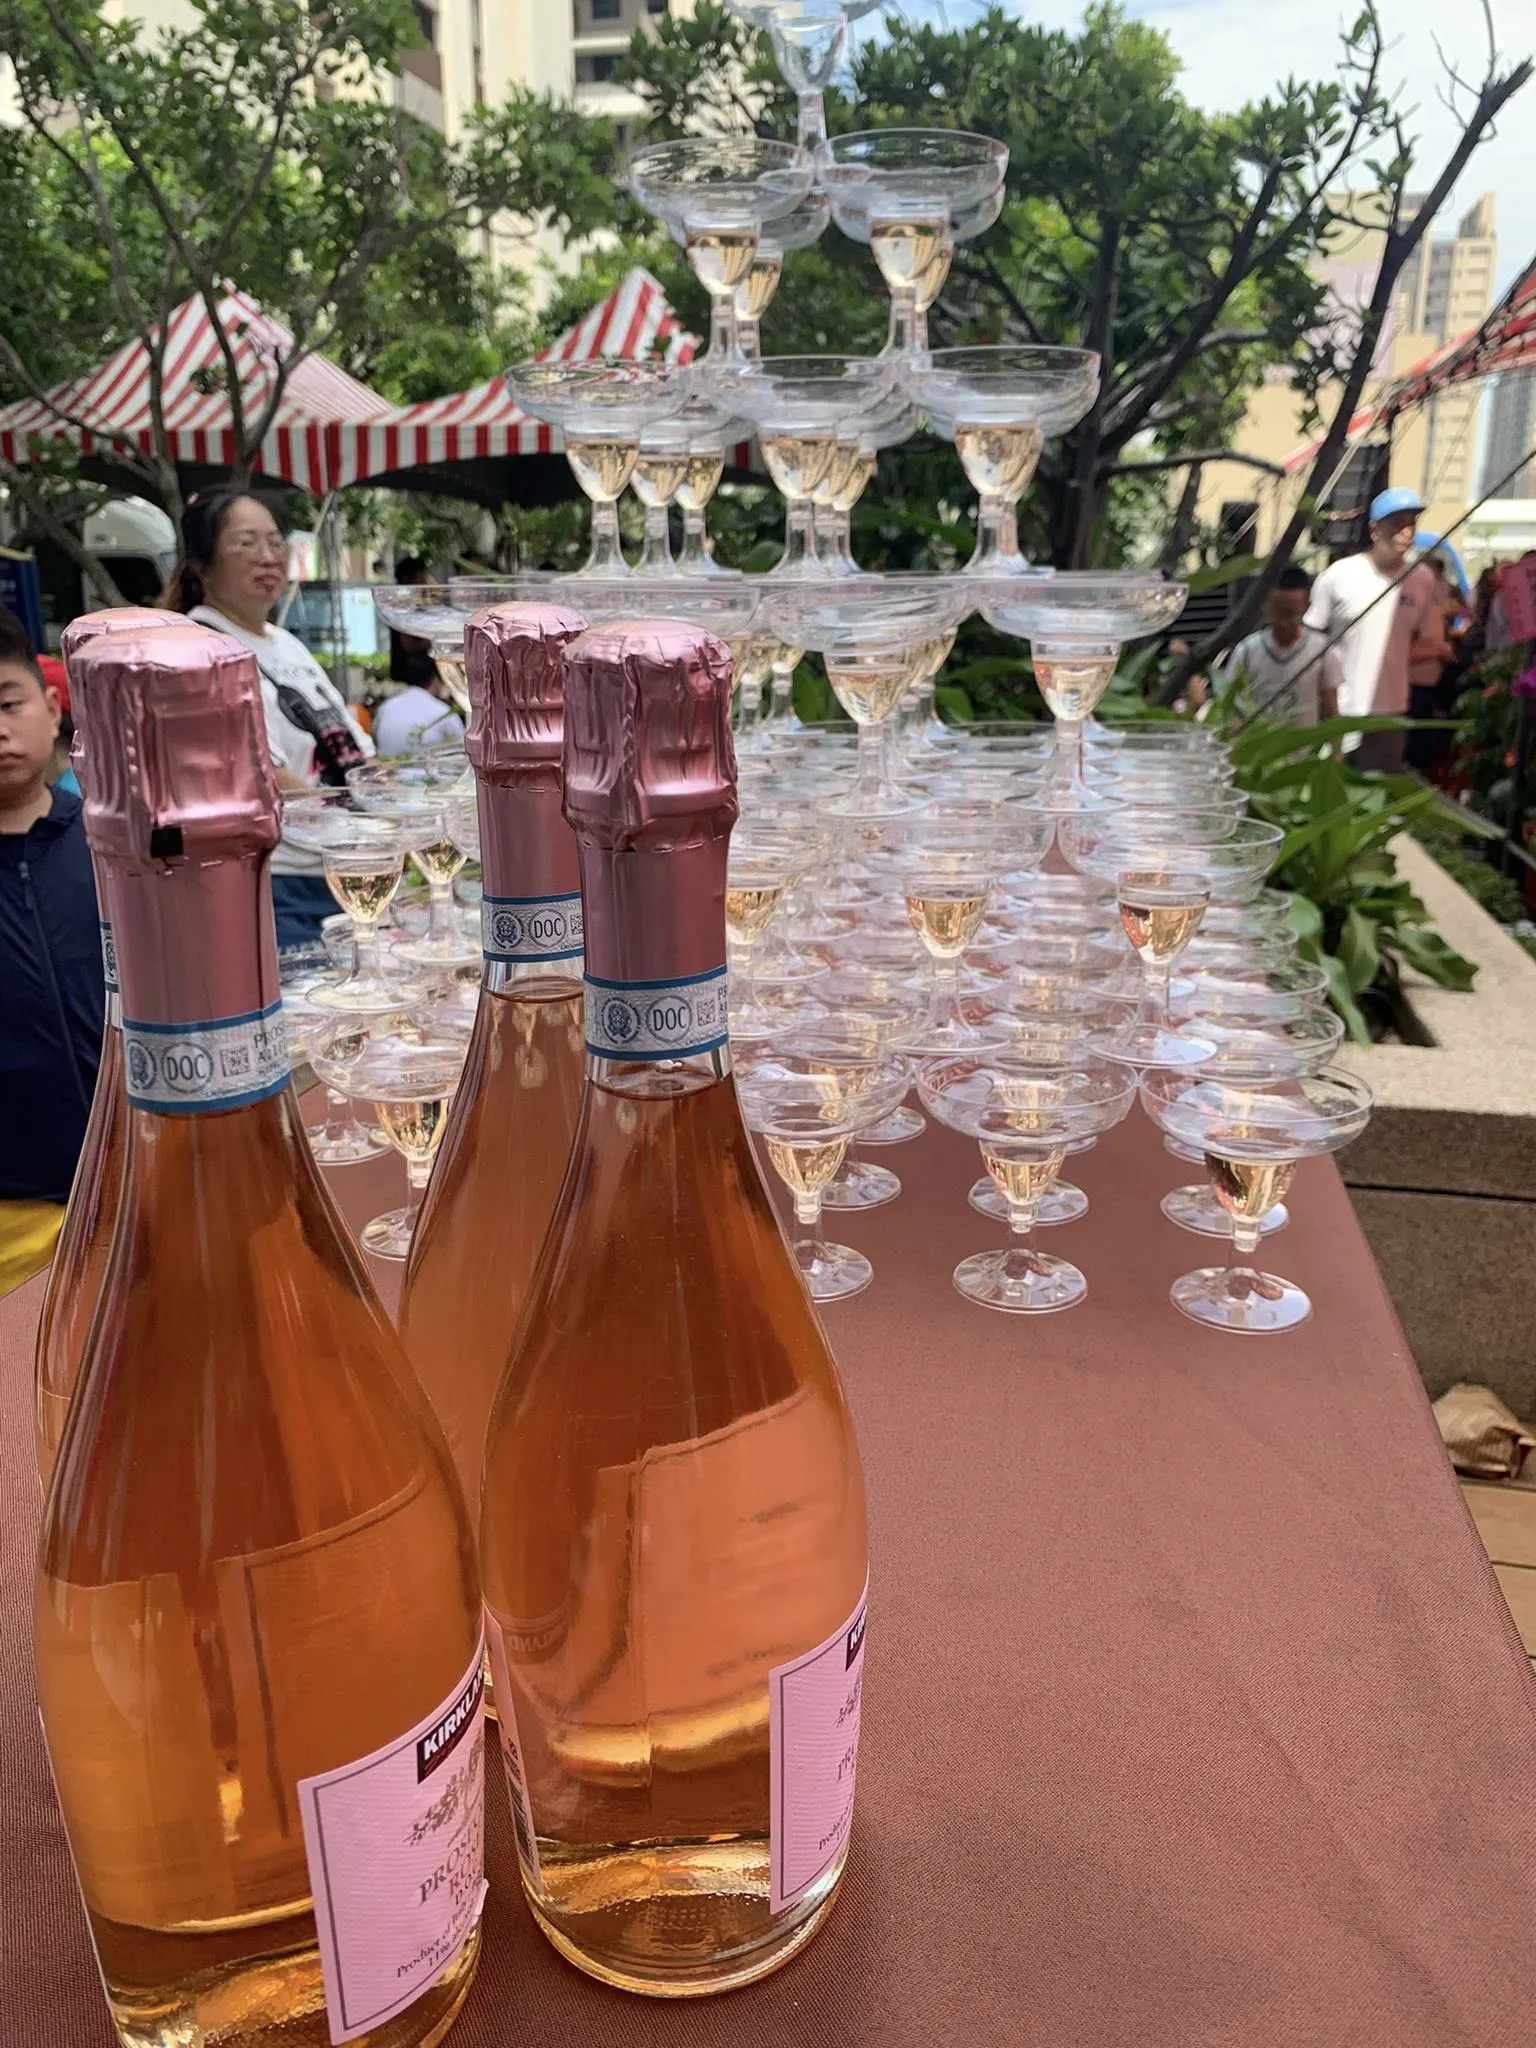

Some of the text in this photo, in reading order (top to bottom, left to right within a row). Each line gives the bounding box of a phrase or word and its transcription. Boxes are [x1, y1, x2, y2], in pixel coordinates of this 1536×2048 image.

[533, 917, 563, 939] DOC
[652, 1006, 687, 1032] DOC
[166, 1054, 206, 1081] DOC
